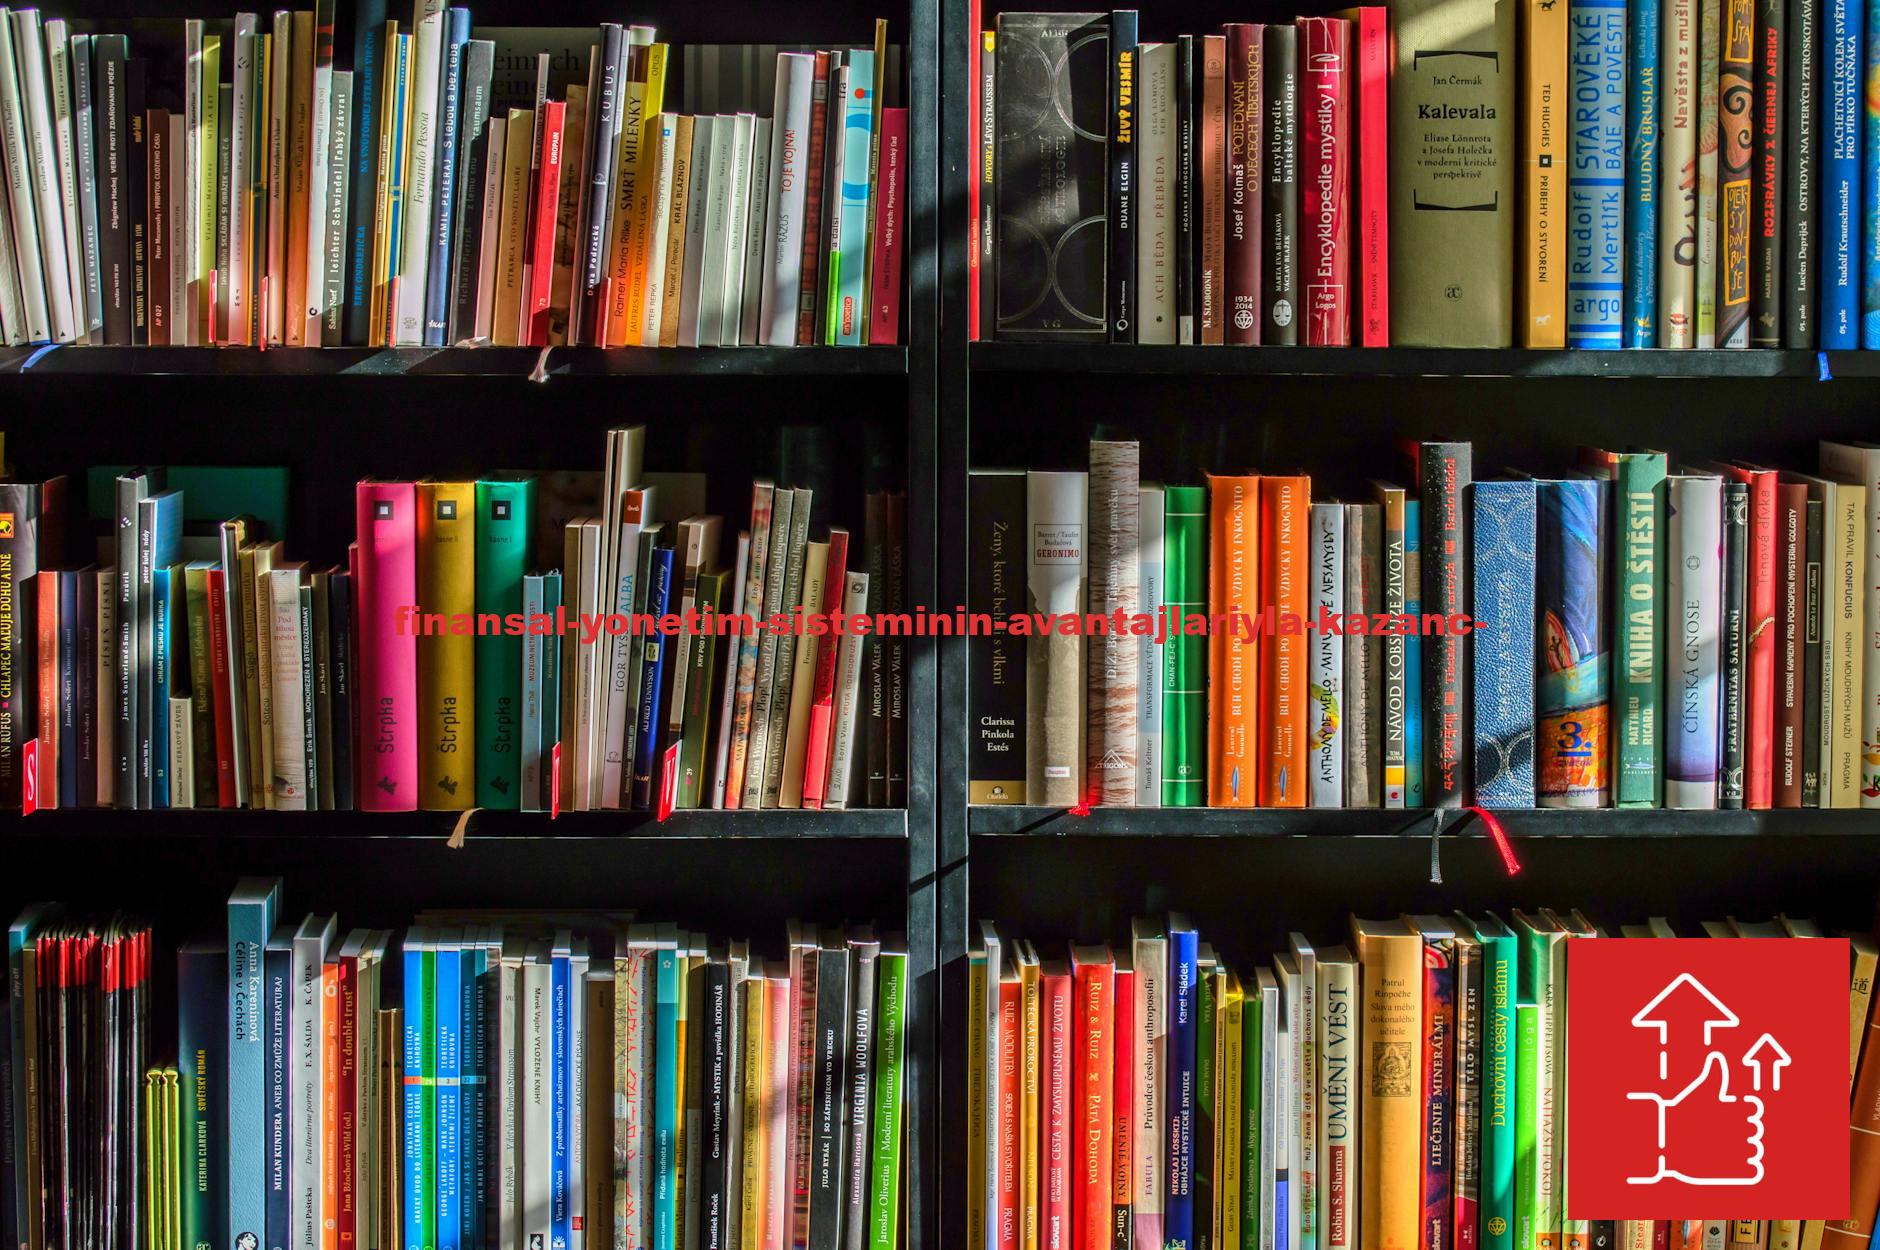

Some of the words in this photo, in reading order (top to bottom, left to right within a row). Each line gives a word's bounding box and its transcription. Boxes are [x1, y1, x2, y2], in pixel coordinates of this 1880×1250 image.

[448, 43, 458, 67] teba
[1605, 14, 1622, 94] POVĚSTI
[1766, 27, 1777, 77] AFRIKY
[1835, 37, 1845, 78] KOLEM
[1846, 36, 1856, 95] TUČŇÁKA
[446, 72, 457, 90] bez
[602, 65, 615, 121] KUBUS
[1118, 51, 1132, 106] VESMÍR
[1433, 76, 1444, 84] Jan
[1446, 75, 1482, 84] Čermák
[1541, 84, 1551, 103] TED
[1572, 15, 1601, 169] STAROVĚKÉ
[984, 75, 994, 144] LÉVI-STRAUSSEM
[1284, 74, 1295, 134] mytologie
[1418, 105, 1496, 119] Kalevala
[1607, 104, 1621, 116] A
[1640, 67, 1654, 135] BRUSLAŘ
[1763, 82, 1777, 135] ČIERNEJ
[1833, 81, 1844, 159] PLACHETNICÍ
[1845, 98, 1856, 133] PÍRKO
[444, 106, 455, 137] tebou
[625, 97, 640, 163] MILENKY
[1117, 110, 1132, 143] ŽIVÝ
[1318, 94, 1336, 159] mystiky
[1541, 106, 1550, 147] HUGHES
[444, 140, 453, 148] S
[783, 130, 795, 164] VOJNA!
[1272, 100, 1282, 183] Encyklopedie
[1605, 127, 1622, 169] BÁJE
[1766, 140, 1776, 149] Z
[1846, 137, 1855, 159] PRO
[782, 168, 794, 177] JE
[985, 150, 993, 183] HOVORY
[1120, 162, 1129, 191] ELGIN
[1284, 139, 1294, 183] baltské
[1639, 141, 1653, 202] BLUDNÝ
[441, 159, 450, 205] PETERAJ
[781, 179, 791, 193] TO
[1233, 164, 1244, 205] Kolmaš
[1248, 180, 1258, 191] O
[1539, 176, 1549, 216] PRÍBEHY
[1762, 154, 1775, 237] ROZPRÁVKY
[439, 211, 448, 245] KAMIL
[777, 214, 789, 242] RÁZUS
[1120, 196, 1129, 228] DUANE
[1233, 210, 1244, 240] Josef
[1317, 164, 1336, 277] Encyklopedie
[1540, 220, 1547, 228] O
[1839, 180, 1849, 251] Krautschneider
[590, 226, 599, 268] Podracká
[619, 220, 631, 244] Rilke
[1573, 191, 1592, 274] Rudolf
[1601, 192, 1619, 274] Mertlík
[617, 247, 628, 278] Maria
[1538, 232, 1548, 282] STVORENÍ
[1838, 254, 1849, 286] Rudolf
[587, 273, 597, 295] Dana
[615, 281, 626, 316] Rainer
[1574, 299, 1620, 321] argo
[1233, 486, 1244, 543] INKOGNITO
[1626, 492, 1653, 574] ŠTĚSTÍ
[1788, 508, 1797, 542] GOLGOTY
[0, 554, 11, 571] INÉ
[1230, 549, 1244, 598] VŽDYCKY
[1386, 541, 1401, 596] ŽIVOTA
[1788, 544, 1796, 580] MYSTERIA
[0, 581, 12, 610] DÚHU
[1631, 583, 1652, 600] O
[1787, 582, 1795, 622] POCHOPENÍ
[0, 611, 12, 651] MAĽUJE
[1232, 638, 1243, 652] PO
[1631, 609, 1652, 683] KNIHA
[1686, 600, 1699, 661] GNOSE
[1729, 609, 1739, 665] SATURNI
[871, 644, 882, 669] VÁLEK
[891, 645, 902, 671] VÁLEK
[1230, 656, 1243, 690] CHODÍ
[1390, 670, 1401, 680] K
[1786, 641, 1794, 671] KAMENY
[1, 653, 12, 698] CHLAPEC
[645, 667, 655, 699] TENNYSON
[1785, 673, 1794, 707] STAVEBNÍ
[872, 673, 881, 717] MIROSLAV
[892, 674, 901, 718] MIROSLAV
[1387, 686, 1401, 740] NÁVOD
[1682, 667, 1699, 733] ČÍNSKÁ
[1728, 668, 1738, 752] FRATERNITAS
[0, 712, 12, 742] RÚFUS
[374, 697, 397, 753] Štrpka
[436, 697, 460, 753] Štrpka
[490, 697, 515, 753] Štrpka
[643, 703, 652, 732] ALFRED
[981, 717, 1014, 725] Clarissa
[981, 730, 1014, 738] Pinkola
[1629, 697, 1639, 744] MATTHIEU
[1643, 708, 1653, 744] RICARD
[987, 743, 1008, 751] Estés
[1785, 726, 1793, 756] STEINER
[1, 746, 11, 777] MILAN
[1785, 758, 1793, 785] RUDOLF
[885, 976, 897, 1016] Východu
[1178, 963, 1189, 995] Sládek
[1491, 960, 1508, 1009] islámu
[274, 977, 283, 1036] LITERATURA?
[1178, 998, 1188, 1023] Karel
[1324, 983, 1347, 1047] VÉST
[1467, 988, 1476, 1010] ZEN
[341, 1021, 353, 1062] double
[854, 1009, 868, 1068] WOOLFOVÁ
[884, 1019, 896, 1064] arabského
[1466, 1017, 1476, 1047] MYSL
[1494, 1013, 1509, 1053] cesty
[273, 1037, 282, 1068] ZMŮŽE
[1431, 1015, 1444, 1096] MINERÁLMI
[1465, 1054, 1475, 1082] TĚLO
[275, 1071, 282, 1083] CO
[882, 1067, 895, 1109] literatury
[1182, 1071, 1190, 1107] INTUICE
[1491, 1057, 1508, 1126] Duchovní
[853, 1073, 866, 1125] VIRGINIA
[1322, 1053, 1347, 1140] UMĚNÍ
[274, 1112, 282, 1157] KUNDERA
[343, 1112, 353, 1129] (ed.)
[880, 1111, 891, 1151] Moderní
[1172, 1116, 1181, 1154] LOSSKIJ:
[1180, 1109, 1190, 1153] MYSTICKÉ
[1430, 1103, 1442, 1165] LIEČENIE
[342, 1131, 352, 1192] Bžochová-Wild
[853, 1134, 862, 1167] Harrisová
[274, 1159, 282, 1190] MILAN
[853, 1169, 861, 1204] Alexandra
[880, 1165, 890, 1206] Oliverius
[1171, 1157, 1180, 1195] NIKOLAJ
[1180, 1156, 1189, 1195] OBHÁJCE
[1332, 1150, 1343, 1192] Sharma
[343, 1194, 352, 1211] Jana
[1332, 1196, 1342, 1205] S.
[877, 1209, 889, 1244] Jaroslav
[1332, 1209, 1342, 1241] Robin
